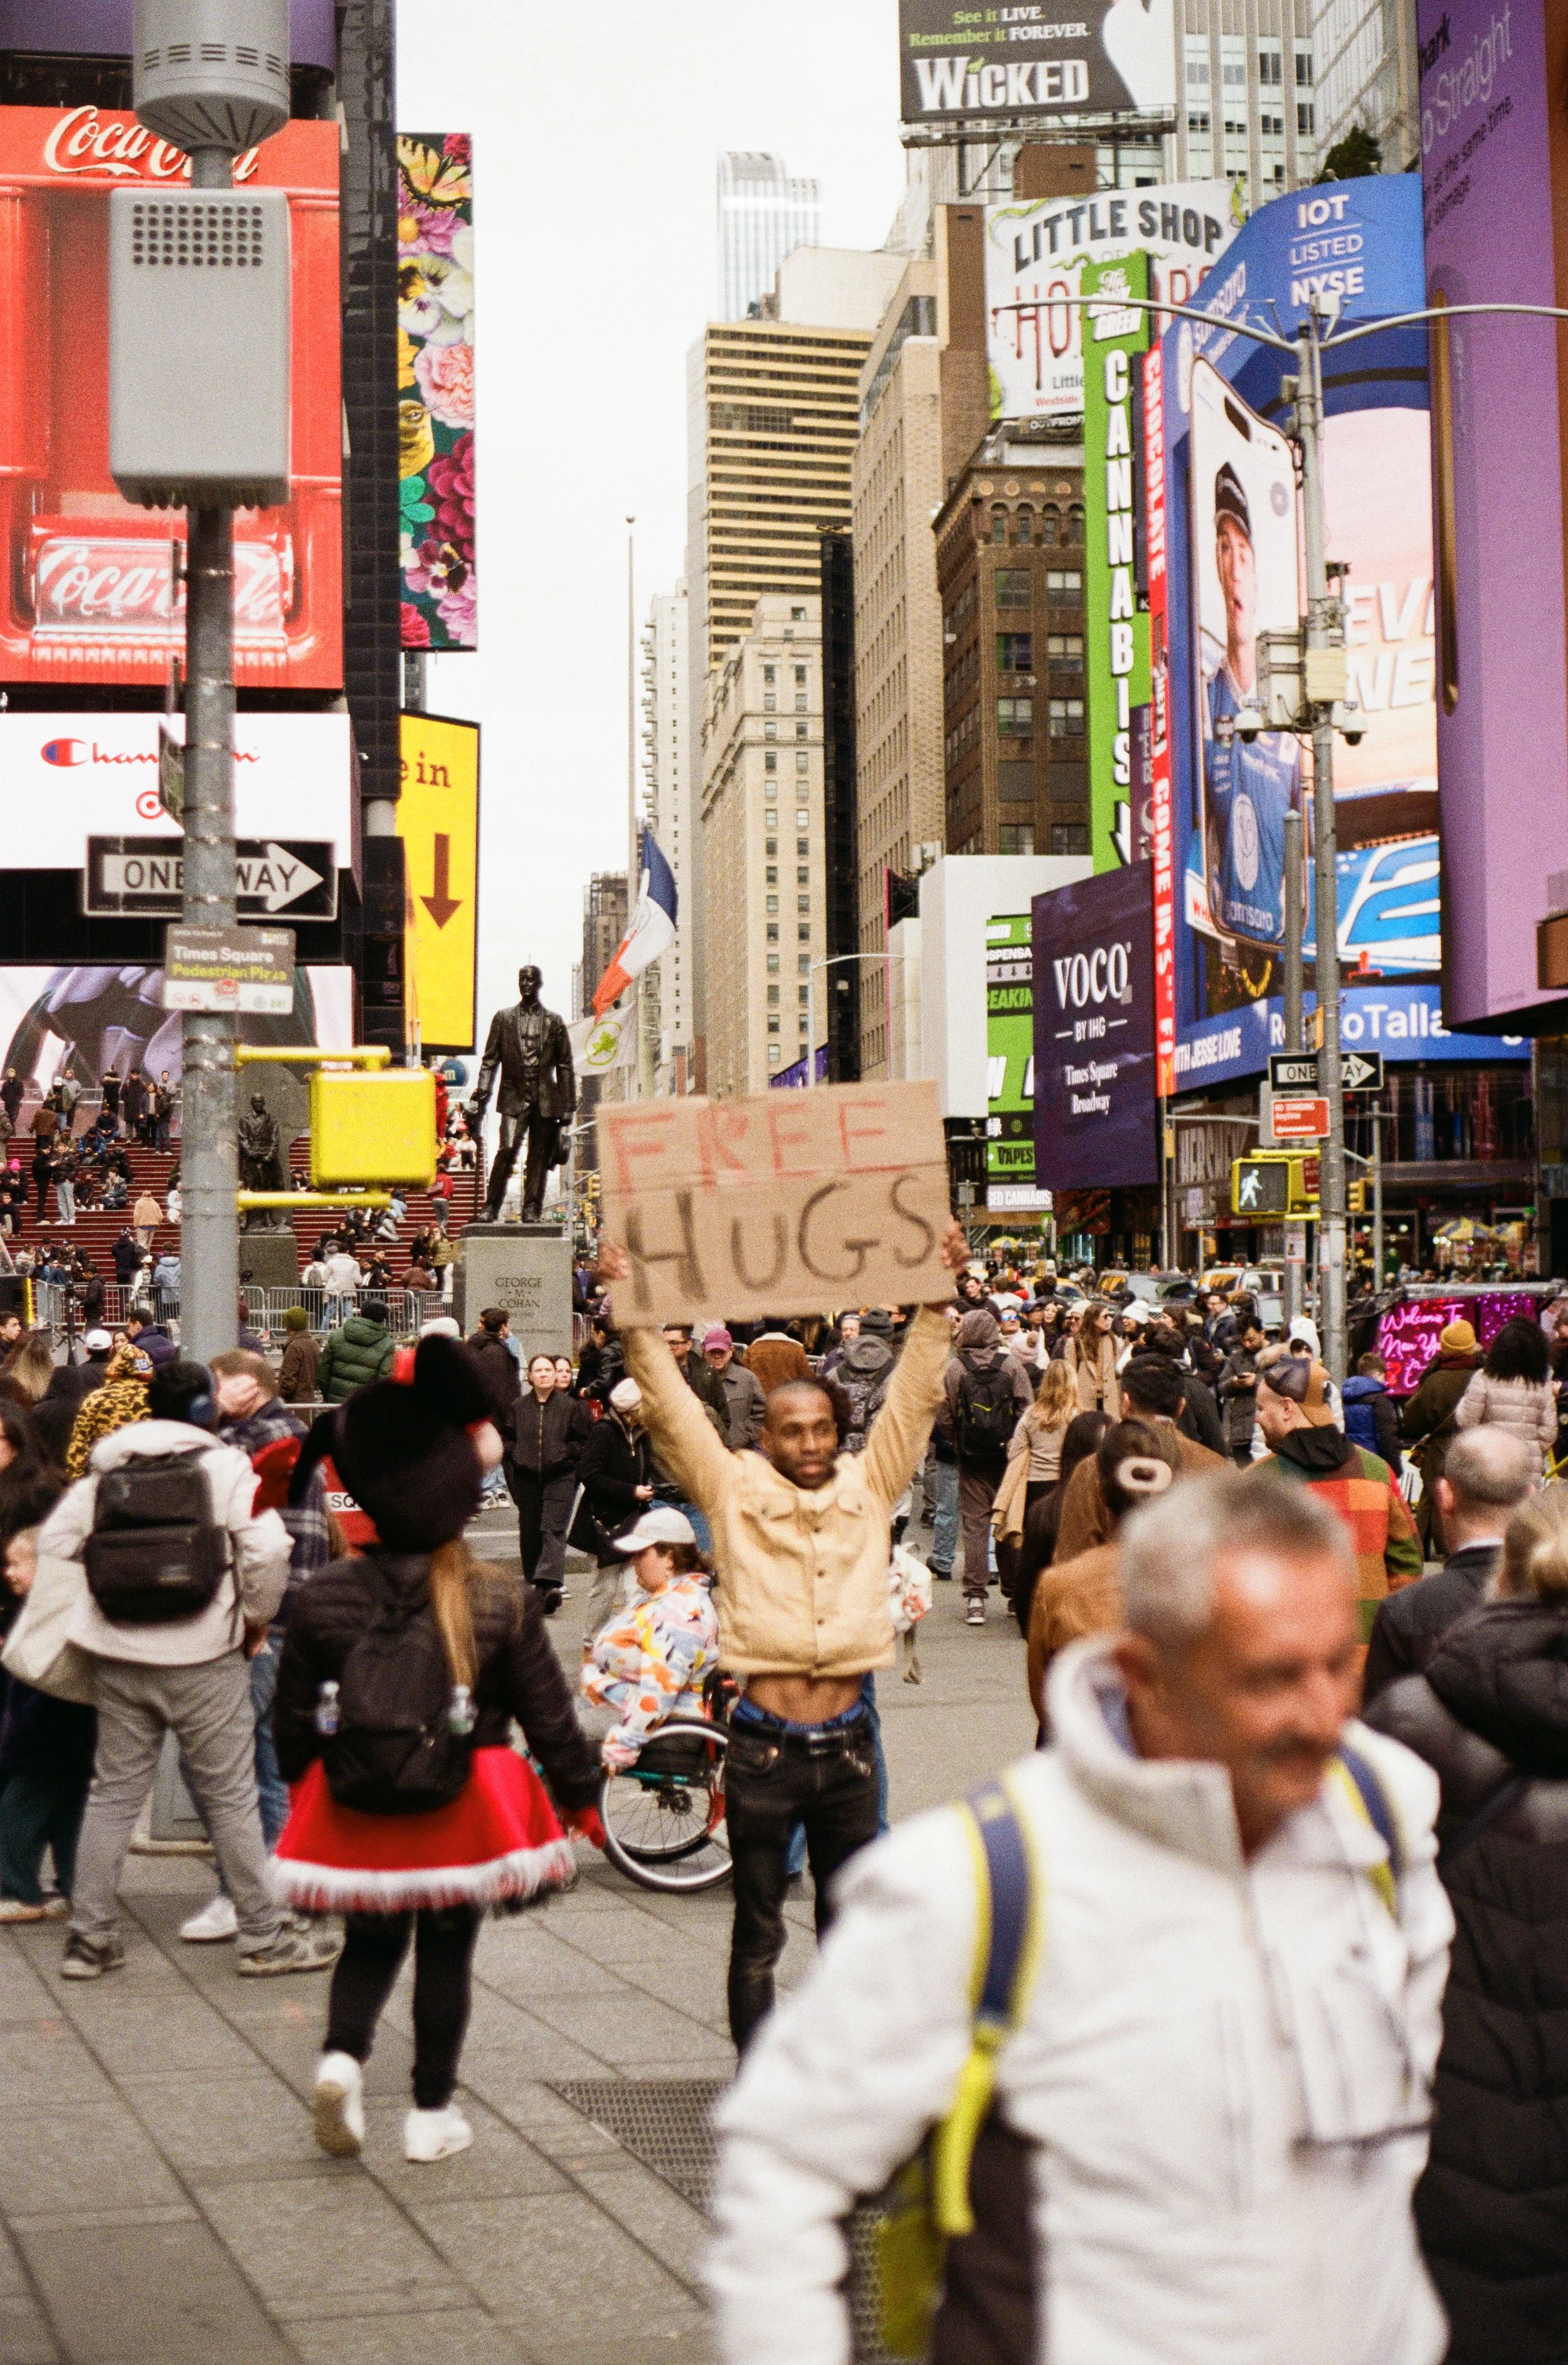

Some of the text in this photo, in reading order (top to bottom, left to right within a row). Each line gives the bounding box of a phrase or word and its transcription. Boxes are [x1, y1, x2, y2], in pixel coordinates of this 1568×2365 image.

[952, 10, 982, 24] See
[908, 29, 990, 47] Remember
[1298, 194, 1350, 230] IOT
[1015, 199, 1222, 274] LITTLE SHOP
[1290, 233, 1364, 266] LISTED
[1290, 265, 1365, 307] NYSE
[1143, 349, 1166, 580] CHOCOLATE
[1104, 349, 1134, 785] CANNABIS
[416, 750, 452, 788] in
[172, 945, 274, 964] Times Square
[1074, 1016, 1106, 1043] BY IHG
[1192, 1035, 1219, 1069] JESSE
[1219, 1026, 1241, 1061] LOVE
[1065, 1060, 1118, 1087] Times Square
[1286, 1062, 1364, 1080] ONE AY
[1071, 1090, 1111, 1115] Broadway
[608, 1101, 908, 1205] FREE
[997, 1145, 1034, 1164] VAPES
[1005, 1189, 1051, 1206] CANNABIS
[625, 1174, 935, 1312] HUGS
[495, 1277, 542, 1288] GEORGE
[498, 1299, 539, 1308] COHAN
[1380, 1304, 1445, 1333] Welcome
[1380, 1332, 1417, 1361] New
[331, 1494, 360, 1509] SQ
